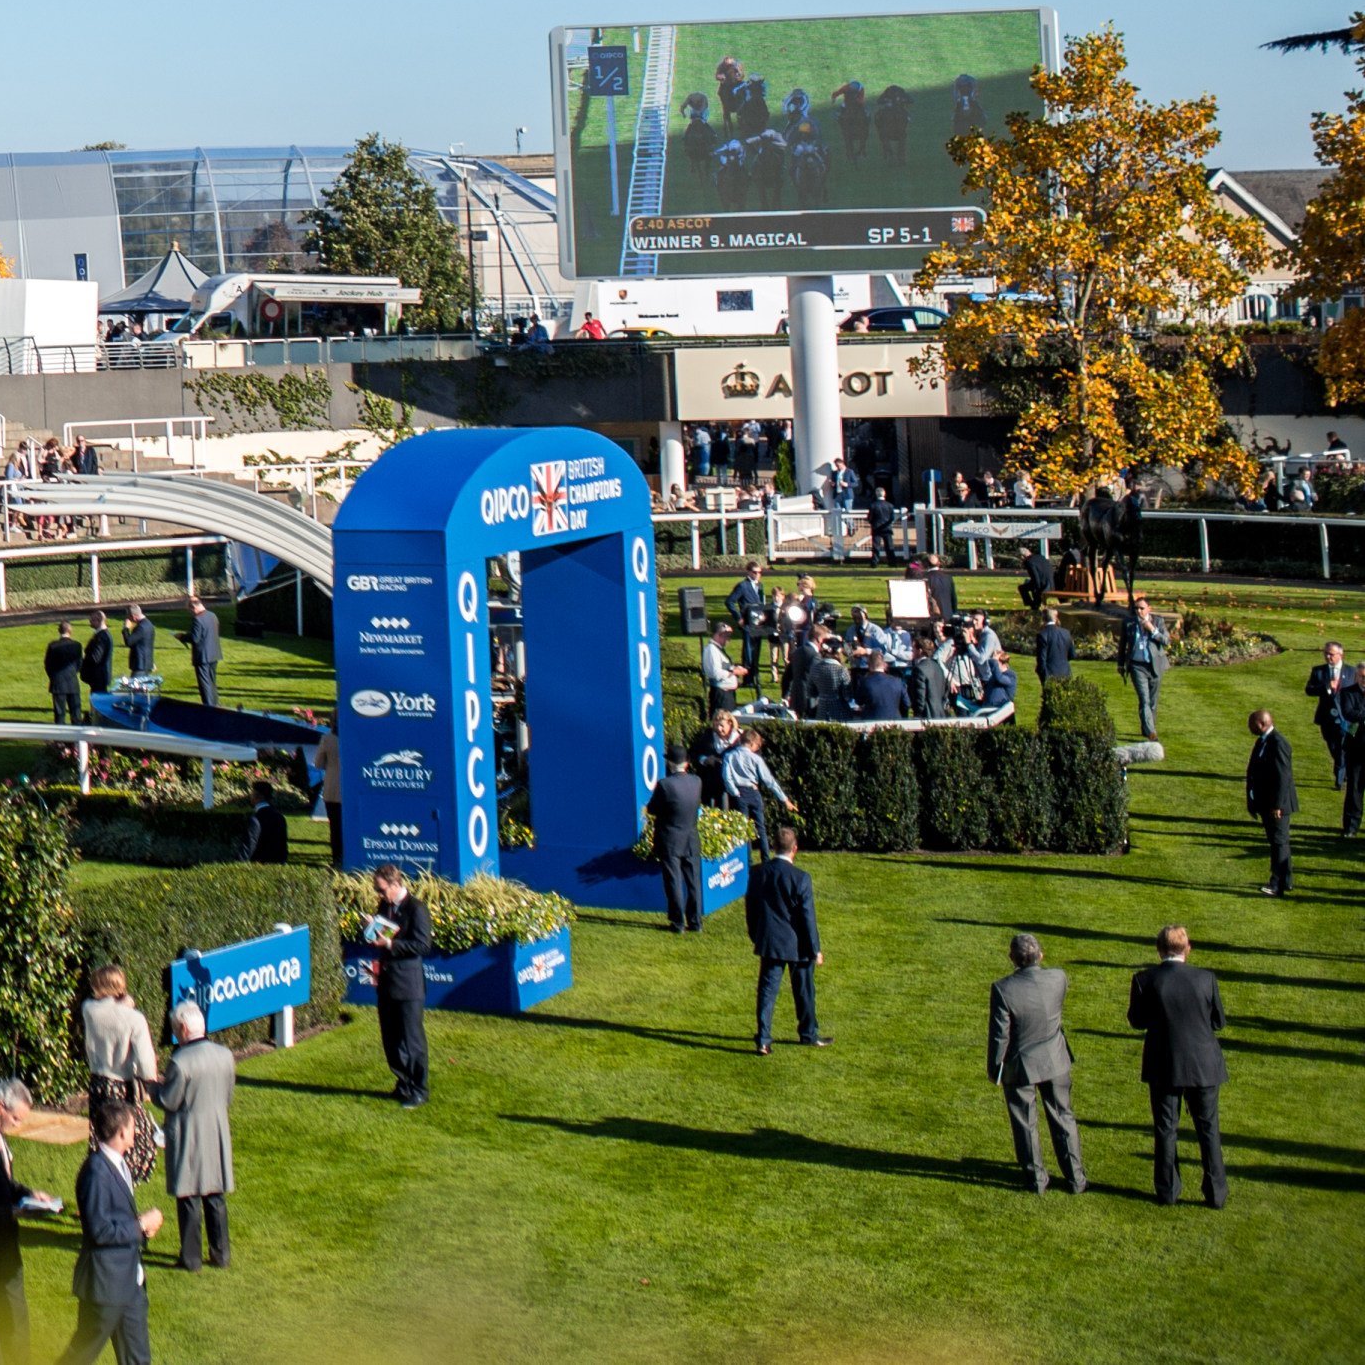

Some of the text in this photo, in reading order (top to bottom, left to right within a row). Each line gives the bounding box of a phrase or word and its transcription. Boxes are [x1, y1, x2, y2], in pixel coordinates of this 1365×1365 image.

[635, 217, 712, 230] 2.40 ASCOT
[634, 232, 808, 250] WINNER 9. MAGICAL
[868, 226, 933, 244] SP 5-1
[336, 289, 363, 297] Jockey
[567, 456, 605, 481] BRITISH
[569, 478, 622, 505] CHAMPIONS
[480, 484, 530, 526] QIPCO
[570, 509, 588, 530] DAY
[346, 574, 379, 592] GBR
[379, 575, 433, 585] GREAT BRITISH
[379, 584, 408, 592] RACING
[631, 536, 659, 792] QIPCO
[389, 691, 436, 712] York
[457, 571, 489, 858] QIPCO
[362, 766, 433, 781] NEWBURY
[371, 780, 426, 790] RACECOURSE
